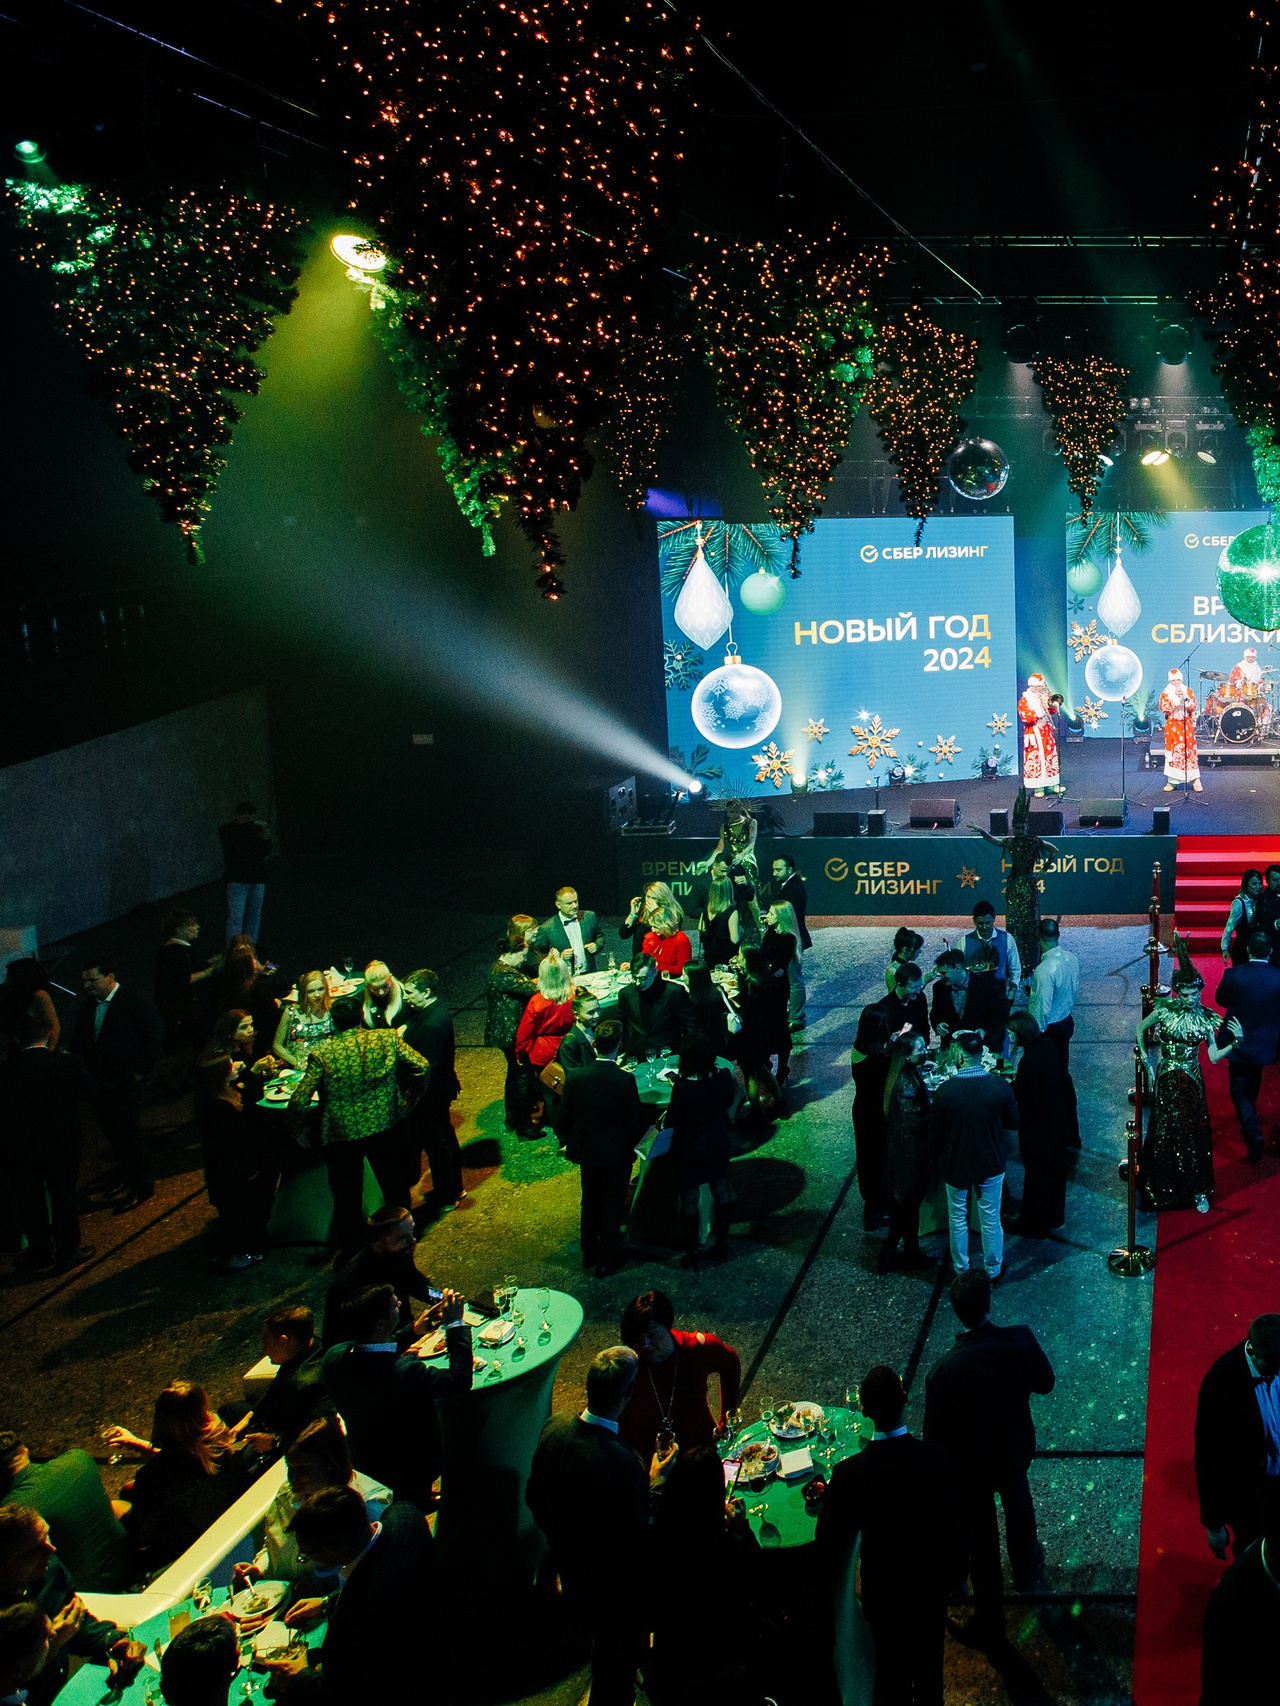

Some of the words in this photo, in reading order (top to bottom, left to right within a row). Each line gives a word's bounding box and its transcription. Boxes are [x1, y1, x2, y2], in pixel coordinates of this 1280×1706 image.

[881, 546, 924, 560] СБЕР
[925, 545, 989, 559] ЛИЗИНГ
[794, 611, 918, 646] НОВЫЙ
[928, 613, 992, 641] ГОД
[923, 645, 992, 672] 2024
[853, 861, 910, 877] СБЕР
[1001, 854, 1077, 873] НВЫЙ
[1083, 857, 1125, 875] ГОД
[854, 879, 943, 895] ЛИЗИНГ
